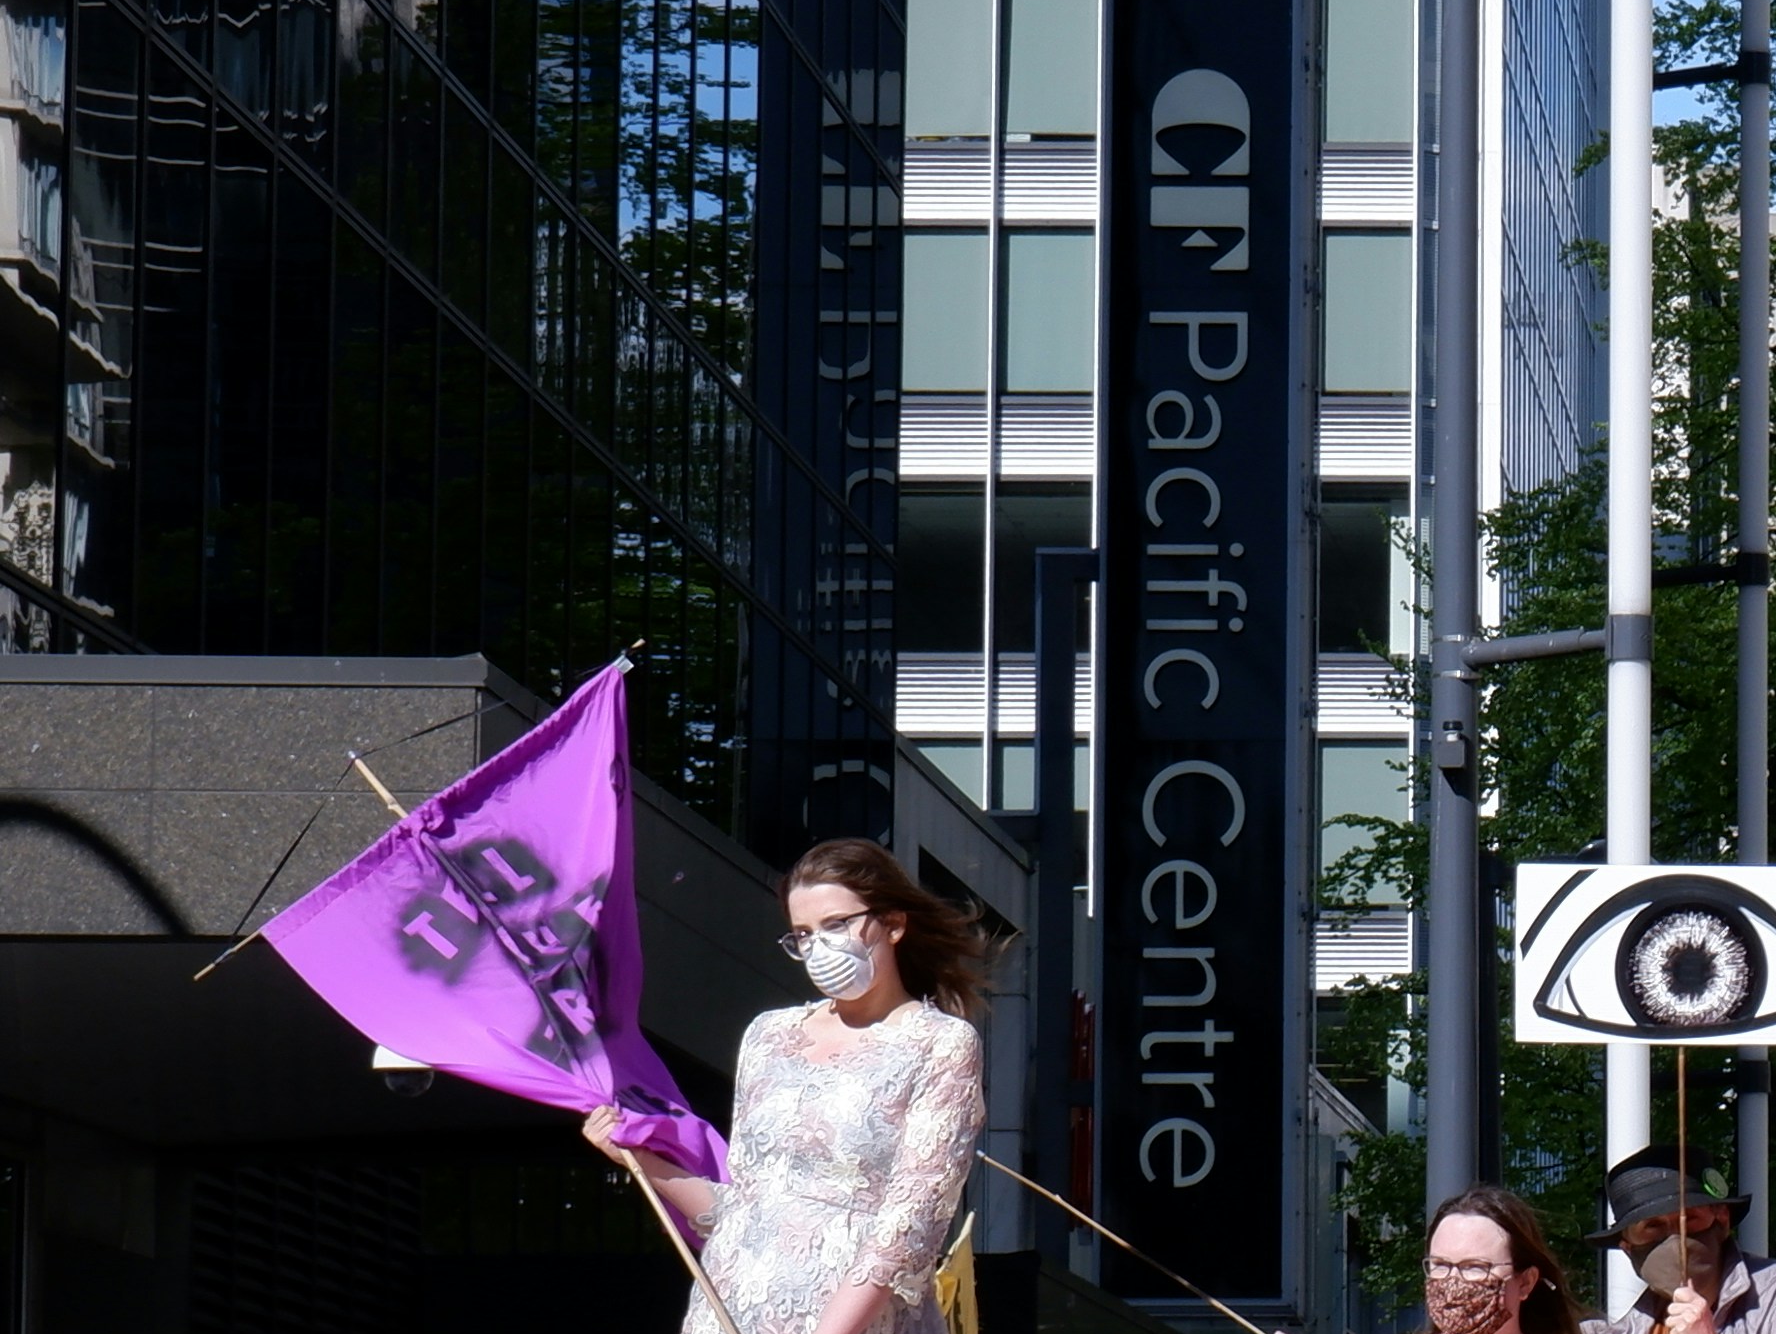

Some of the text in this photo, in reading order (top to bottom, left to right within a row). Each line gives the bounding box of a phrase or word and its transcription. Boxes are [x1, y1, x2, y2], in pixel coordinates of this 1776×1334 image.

[1140, 68, 1249, 1189] CF Pacific Centre
